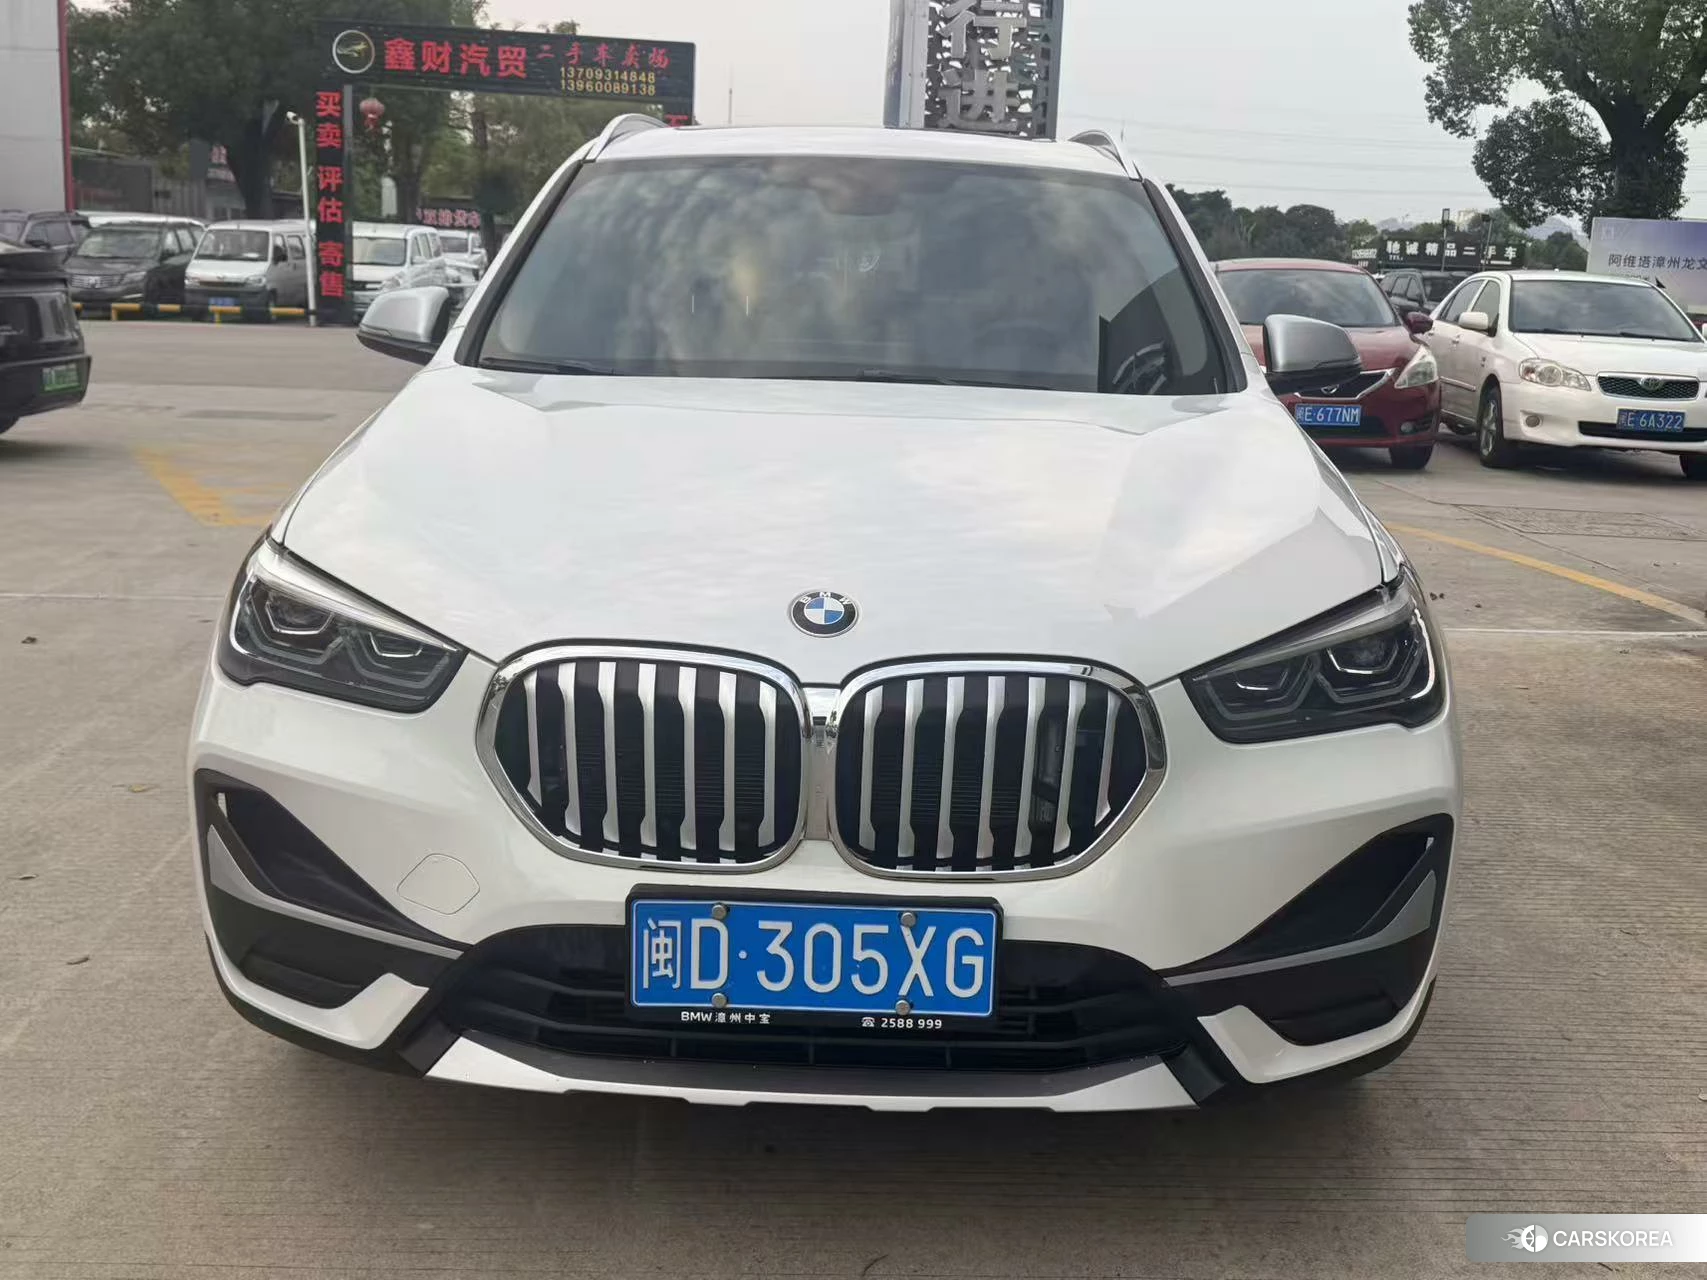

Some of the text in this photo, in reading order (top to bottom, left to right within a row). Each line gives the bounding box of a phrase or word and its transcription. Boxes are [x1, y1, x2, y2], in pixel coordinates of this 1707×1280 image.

[384, 38, 527, 79] 鑫财汽贸
[560, 67, 656, 84] 13709314848
[316, 92, 344, 297] 买卖 评估 寄售
[800, 592, 852, 604] BMW
[643, 917, 984, 998] 闽D·305XG
[881, 1018, 942, 1029] 2588 999
